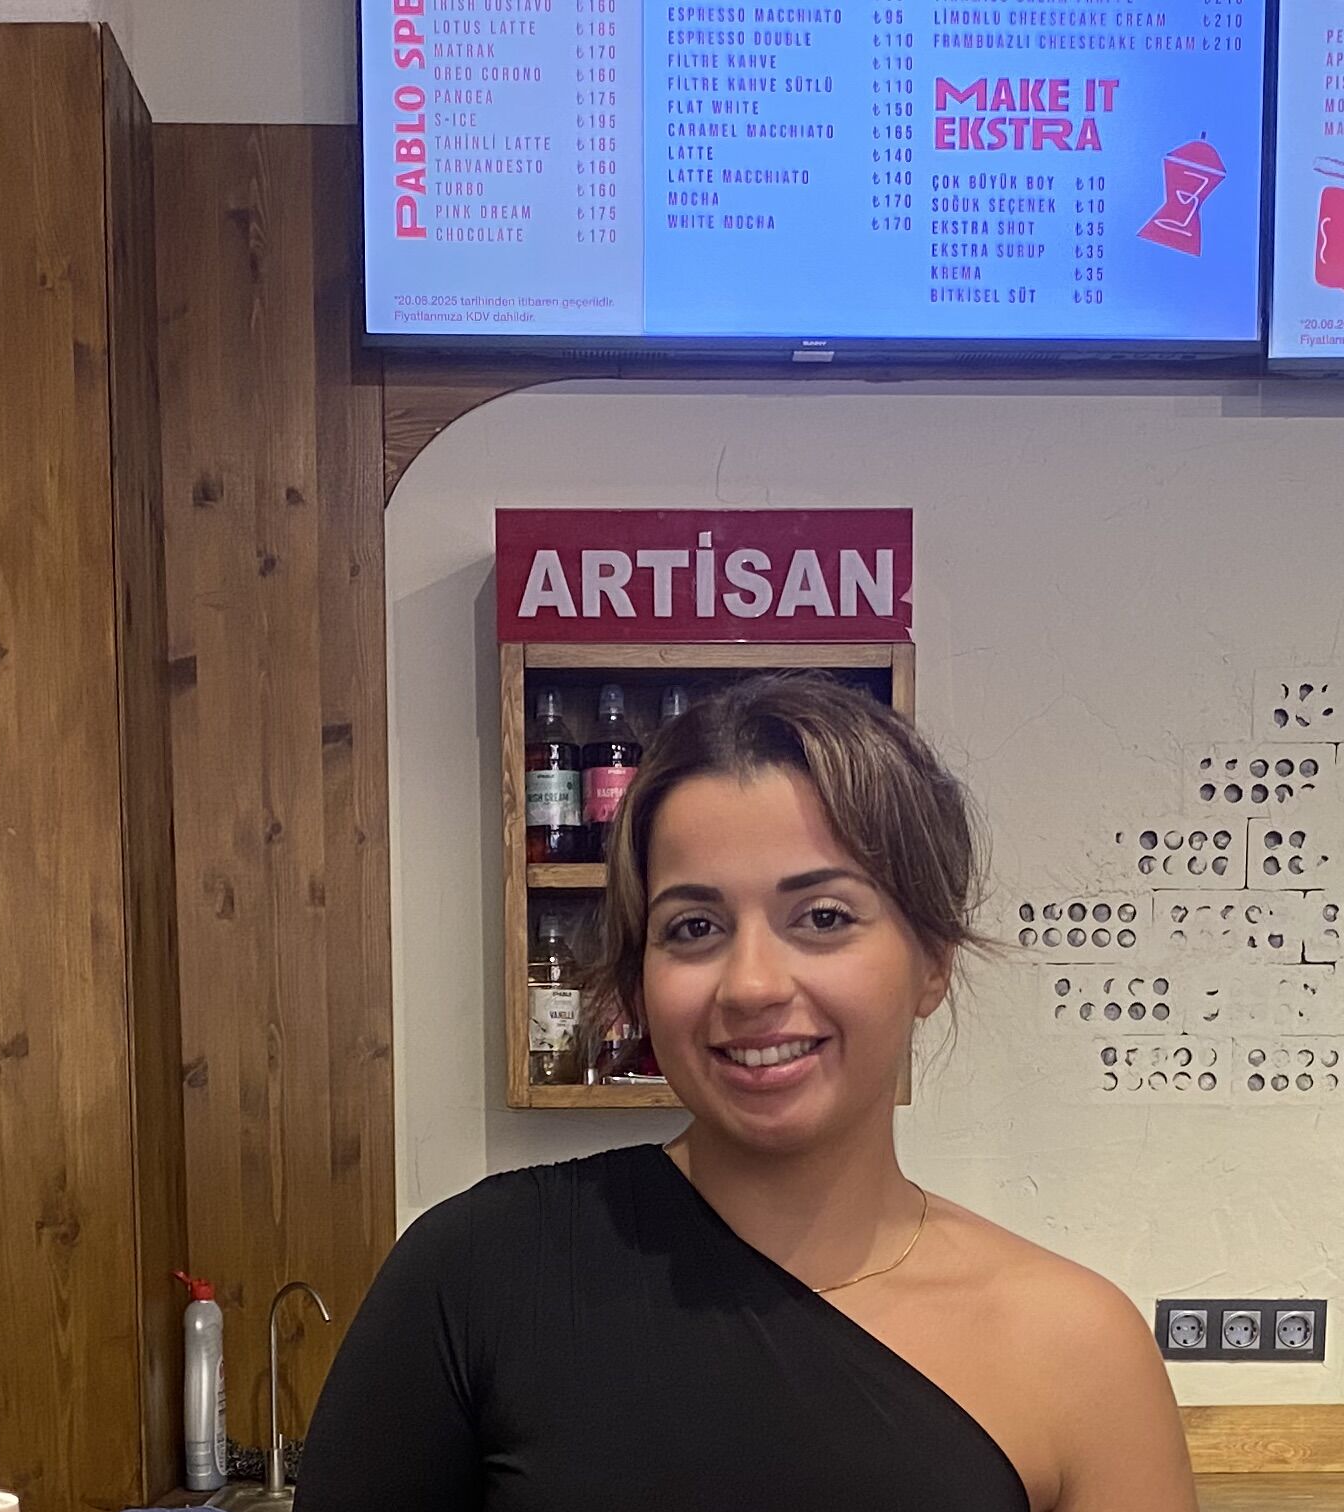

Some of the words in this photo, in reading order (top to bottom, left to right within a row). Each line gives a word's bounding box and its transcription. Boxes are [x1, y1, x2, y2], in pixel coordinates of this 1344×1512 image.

[668, 7, 745, 22] ESPRESSO
[756, 8, 842, 24] MACCHIATO
[1010, 12, 1106, 27] CHEESECAKE
[1117, 13, 1166, 27] CREAM
[433, 20, 481, 35] LOTUS
[490, 21, 536, 36] LATTE
[668, 31, 745, 45] ESPRESSO
[755, 31, 812, 46] DOUBLE
[1040, 35, 1135, 50] CHEESECAKE
[1146, 36, 1195, 50] CREAM
[434, 43, 495, 58] MATRAK
[668, 51, 718, 68] FİLTRE
[728, 54, 776, 69] KAHVE
[434, 66, 472, 81] OREO
[481, 67, 541, 81] CORONO
[668, 74, 718, 91] FİLTRE
[728, 77, 776, 92] KAHVE
[785, 76, 832, 92] SÜTLÜ
[434, 89, 493, 104] PANGEA
[935, 77, 1069, 112] MAKE
[1086, 79, 1119, 112] IT
[668, 100, 702, 115] FLAT
[712, 100, 759, 115] WHITE
[434, 112, 476, 127] S-ICE
[668, 123, 737, 138] CARAMEL
[747, 124, 834, 139] MACCHIATO
[935, 116, 1101, 151] EKSTRA
[435, 133, 496, 150] TAHİNLİ
[505, 137, 551, 150] LATTE
[668, 146, 713, 160] LATTE
[394, 86, 427, 238] PABLO
[668, 169, 713, 184] LATTE
[722, 169, 808, 185] MACCHIATO
[932, 175, 959, 191] ÇOK
[969, 173, 1017, 189] BÜYÜK
[1027, 176, 1054, 190] BOY
[436, 182, 484, 196] TURBO
[667, 191, 719, 206] MOCHA
[436, 205, 471, 219] PINK
[481, 205, 531, 219] DREAM
[989, 199, 1055, 215] SEÇENEK
[667, 215, 714, 230] WHITE
[724, 216, 775, 230] MOCHA
[932, 221, 988, 234] EKSTRA
[998, 221, 1034, 235] SHOT
[436, 228, 524, 242] CHOCOLATE
[931, 243, 988, 257] EKSTRA
[931, 266, 981, 279] KREMA
[1009, 287, 1035, 303] SÜT
[466, 312, 489, 321] KDV
[518, 531, 894, 618] ARTİSAN
